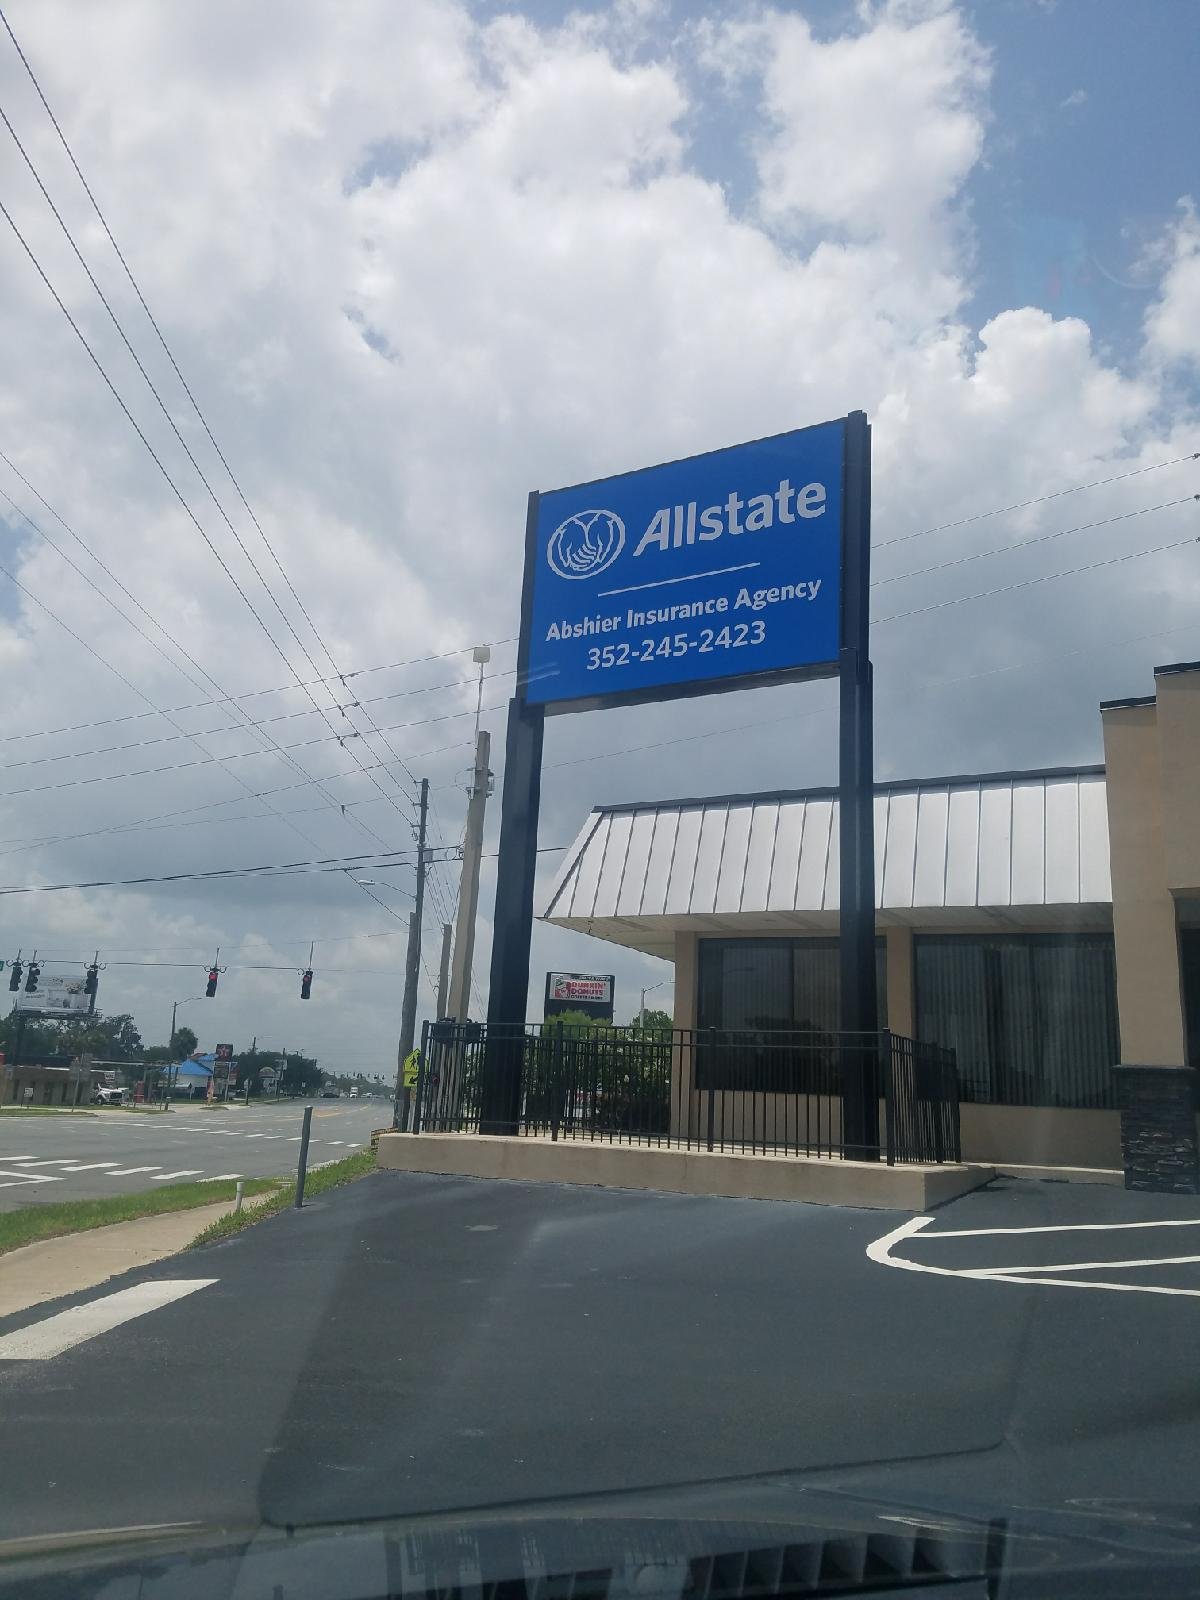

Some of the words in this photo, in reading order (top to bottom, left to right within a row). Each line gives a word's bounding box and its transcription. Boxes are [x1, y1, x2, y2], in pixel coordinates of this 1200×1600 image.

[633, 479, 827, 556] Allstate
[546, 614, 621, 641] Abshier
[628, 598, 728, 628] Insurance
[734, 579, 822, 611] Agency
[587, 621, 766, 670] 352-245-2423
